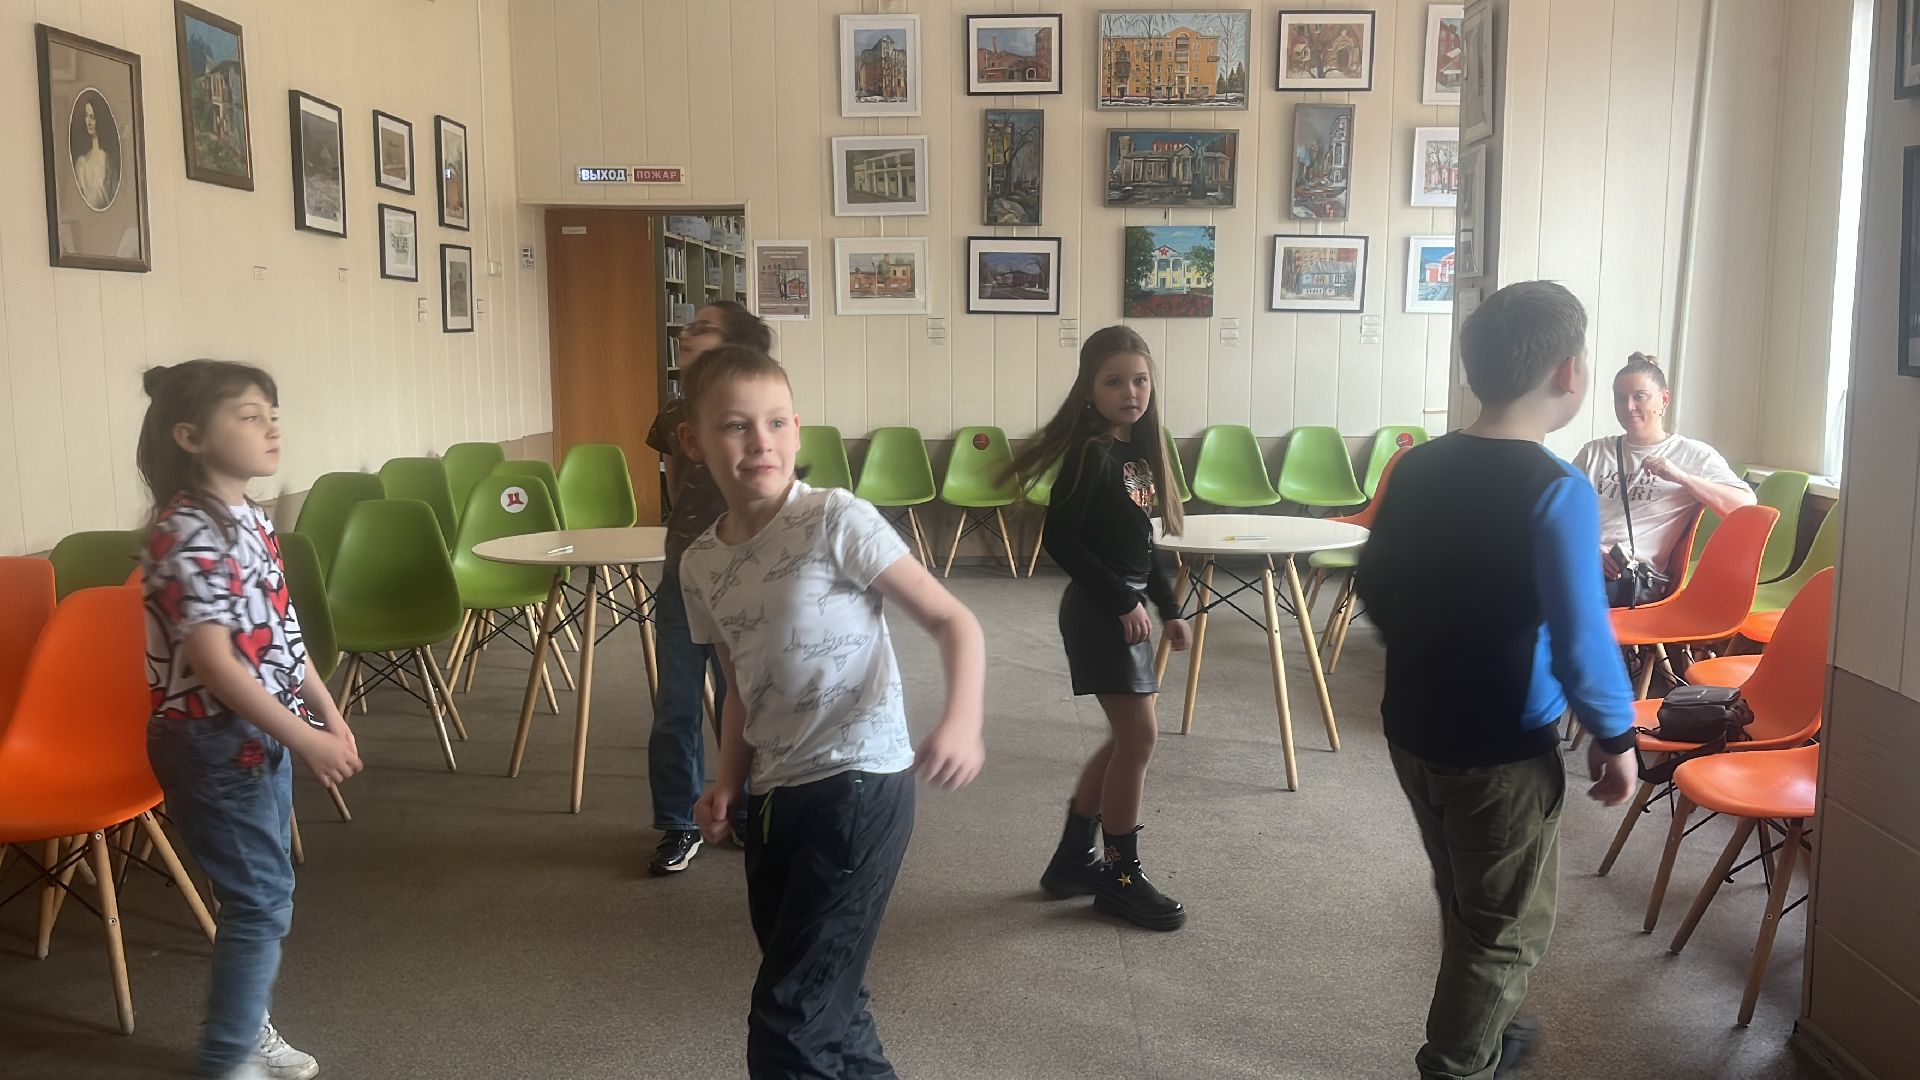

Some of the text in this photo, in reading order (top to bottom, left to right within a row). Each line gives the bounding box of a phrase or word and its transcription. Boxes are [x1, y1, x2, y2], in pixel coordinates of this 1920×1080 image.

[581, 169, 626, 181] ВЫХОД
[636, 170, 677, 180] ПОЖАР
[1597, 480, 1661, 502] VIRE
